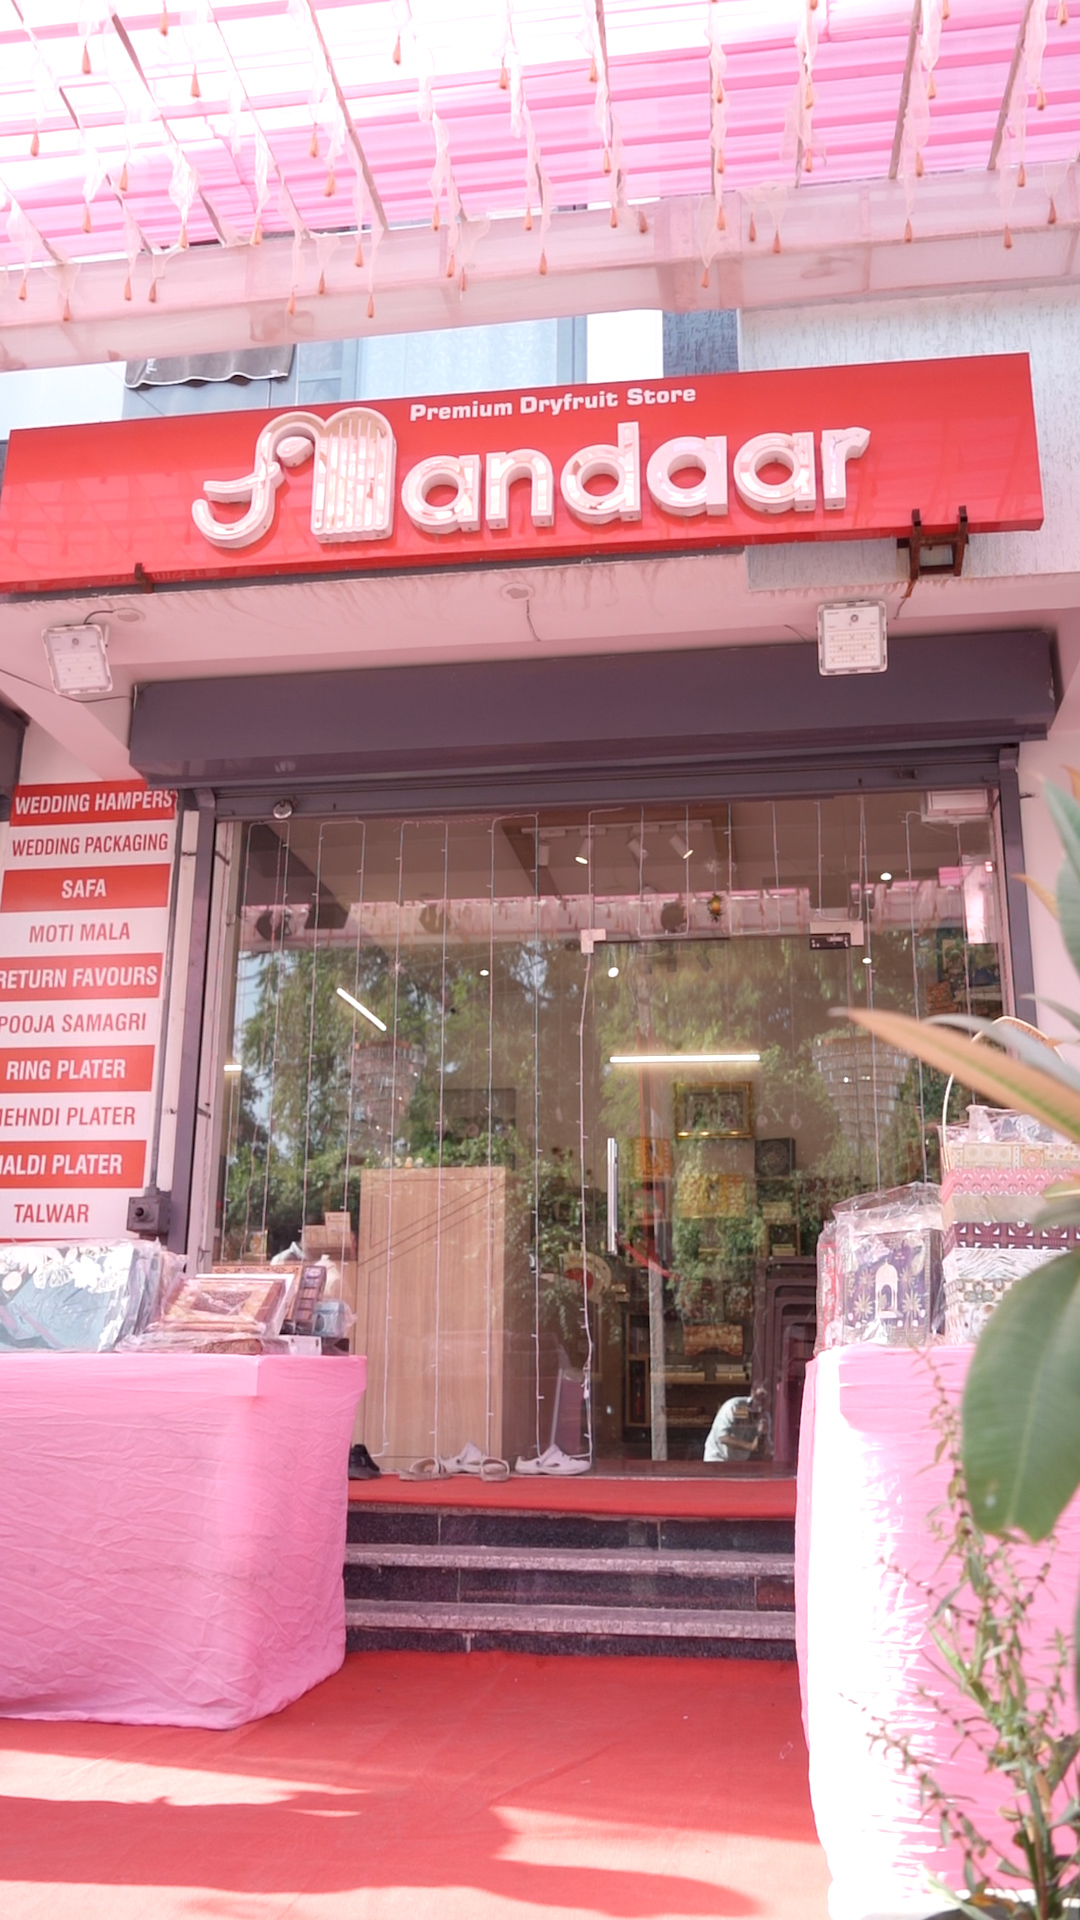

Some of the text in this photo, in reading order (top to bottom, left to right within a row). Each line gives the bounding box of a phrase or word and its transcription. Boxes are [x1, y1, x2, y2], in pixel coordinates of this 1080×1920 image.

[410, 387, 697, 421] Premium Dryfruit Store
[15, 789, 173, 815] WEDDING HAMPERS
[12, 833, 168, 857] WEDDING PACKAGING
[61, 878, 107, 899] SAFA
[29, 922, 130, 943] MOTI MALA
[0, 965, 158, 990] RETURN FAVOURS
[0, 1013, 147, 1034] POOJA SAMAGRI
[6, 1058, 126, 1081] RING PLATER
[0, 1106, 136, 1127] EHNDI PLATER
[51, 1153, 123, 1175] PLATER
[14, 1203, 90, 1224] TALWAR
